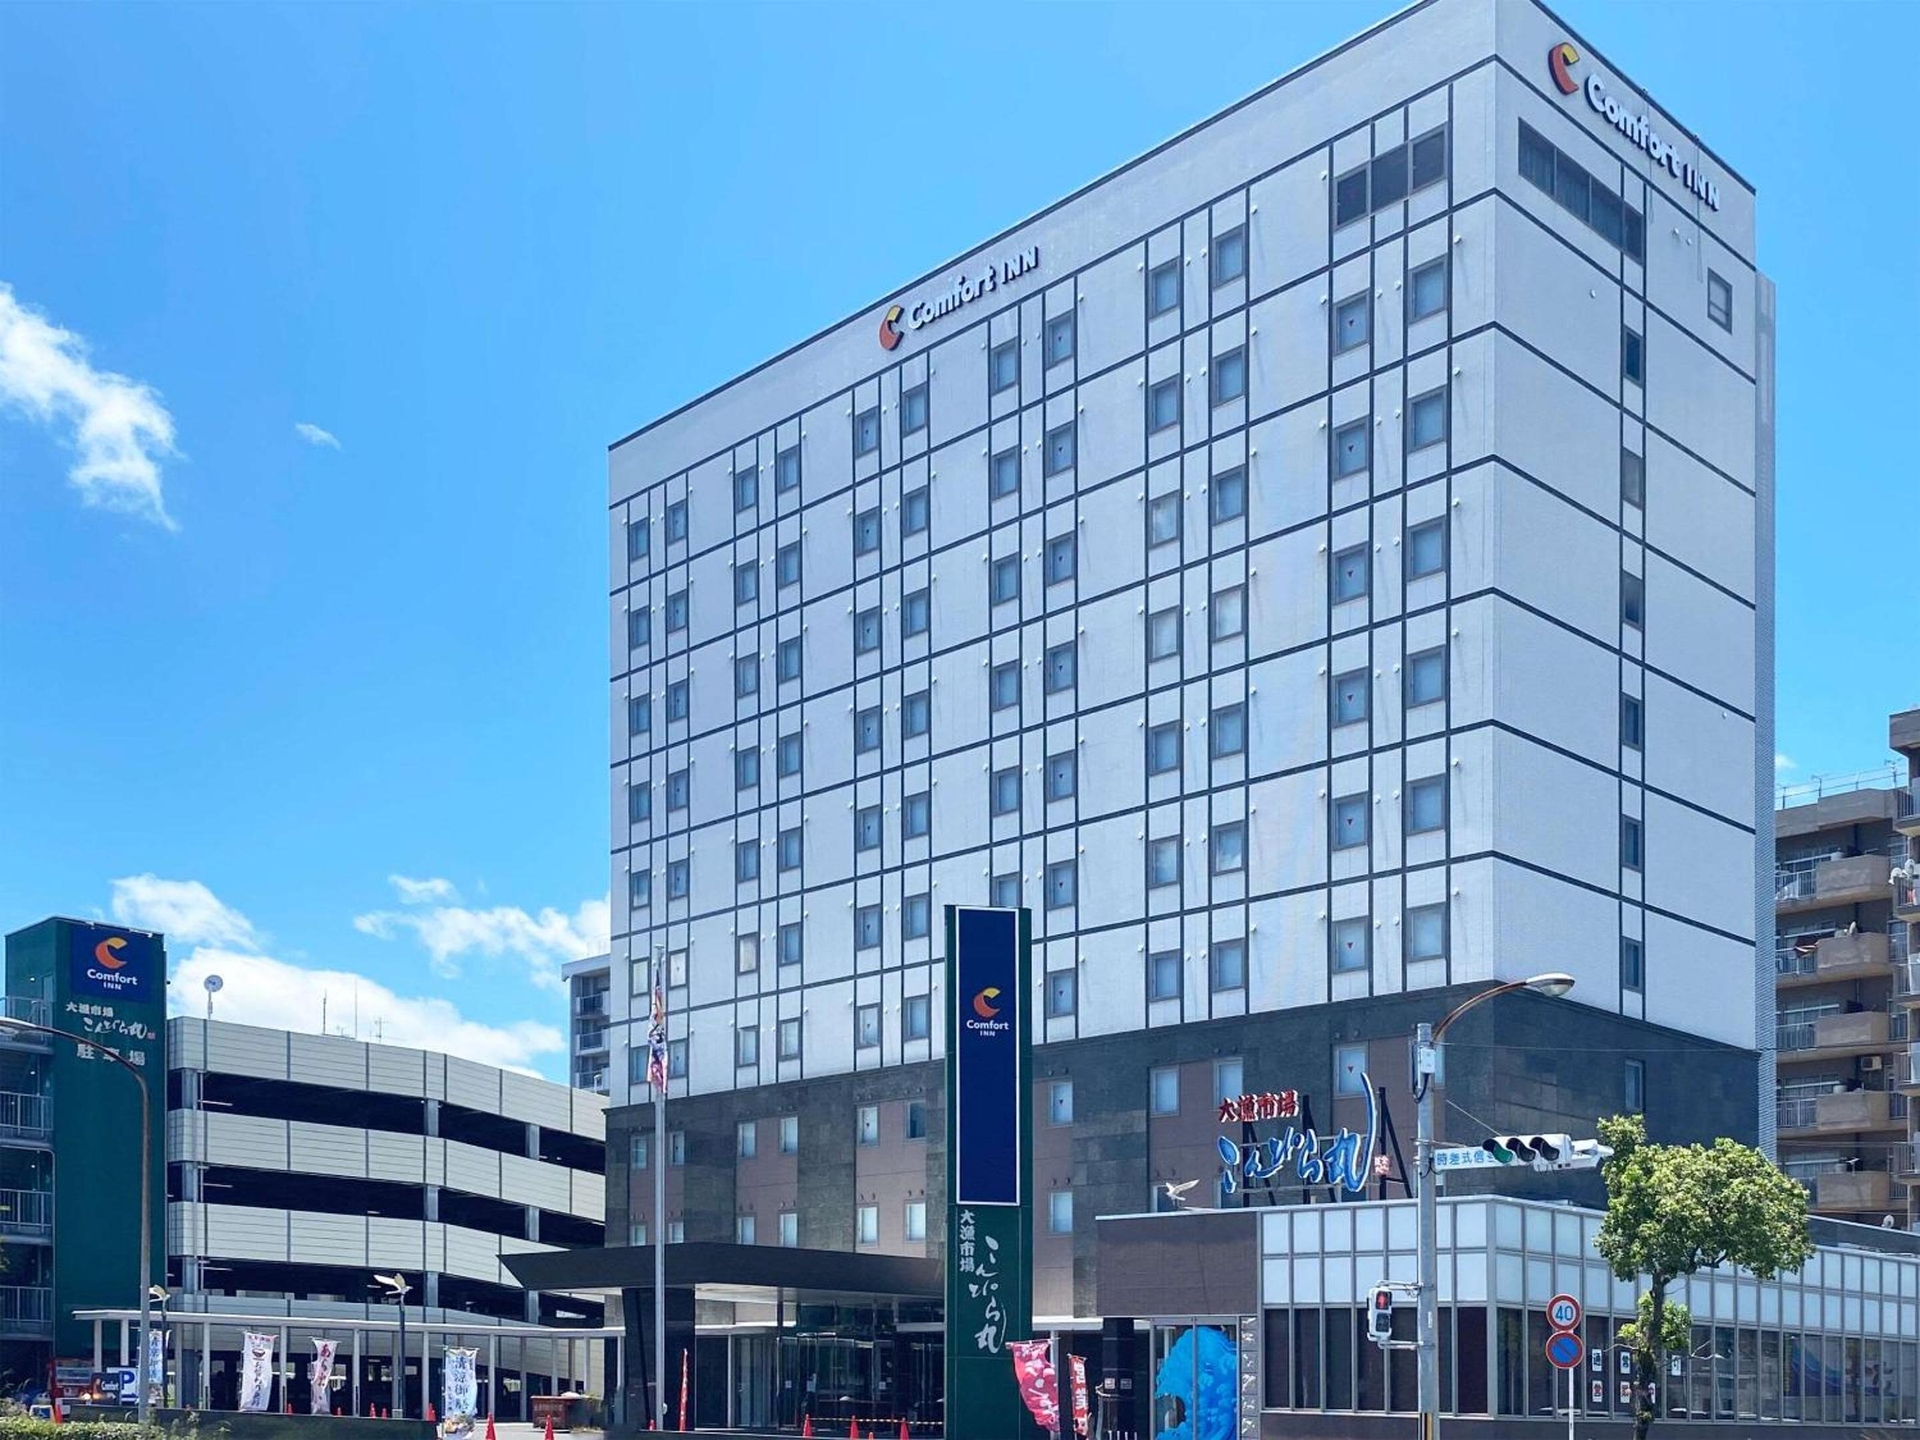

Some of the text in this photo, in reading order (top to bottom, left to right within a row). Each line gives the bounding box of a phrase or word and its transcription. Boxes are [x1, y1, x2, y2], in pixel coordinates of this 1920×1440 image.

[1584, 73, 1720, 212] Comfort INN
[908, 246, 1039, 330] Comfort INN
[87, 968, 138, 985] Comfort
[103, 981, 122, 990] INN
[966, 1020, 1009, 1030] Comfort
[76, 1043, 146, 1066] 駐車場
[1219, 1089, 1299, 1123] 大漁市場
[960, 1209, 975, 1272] 大漁市場
[1555, 1305, 1574, 1321] 40
[121, 1370, 135, 1390] P
